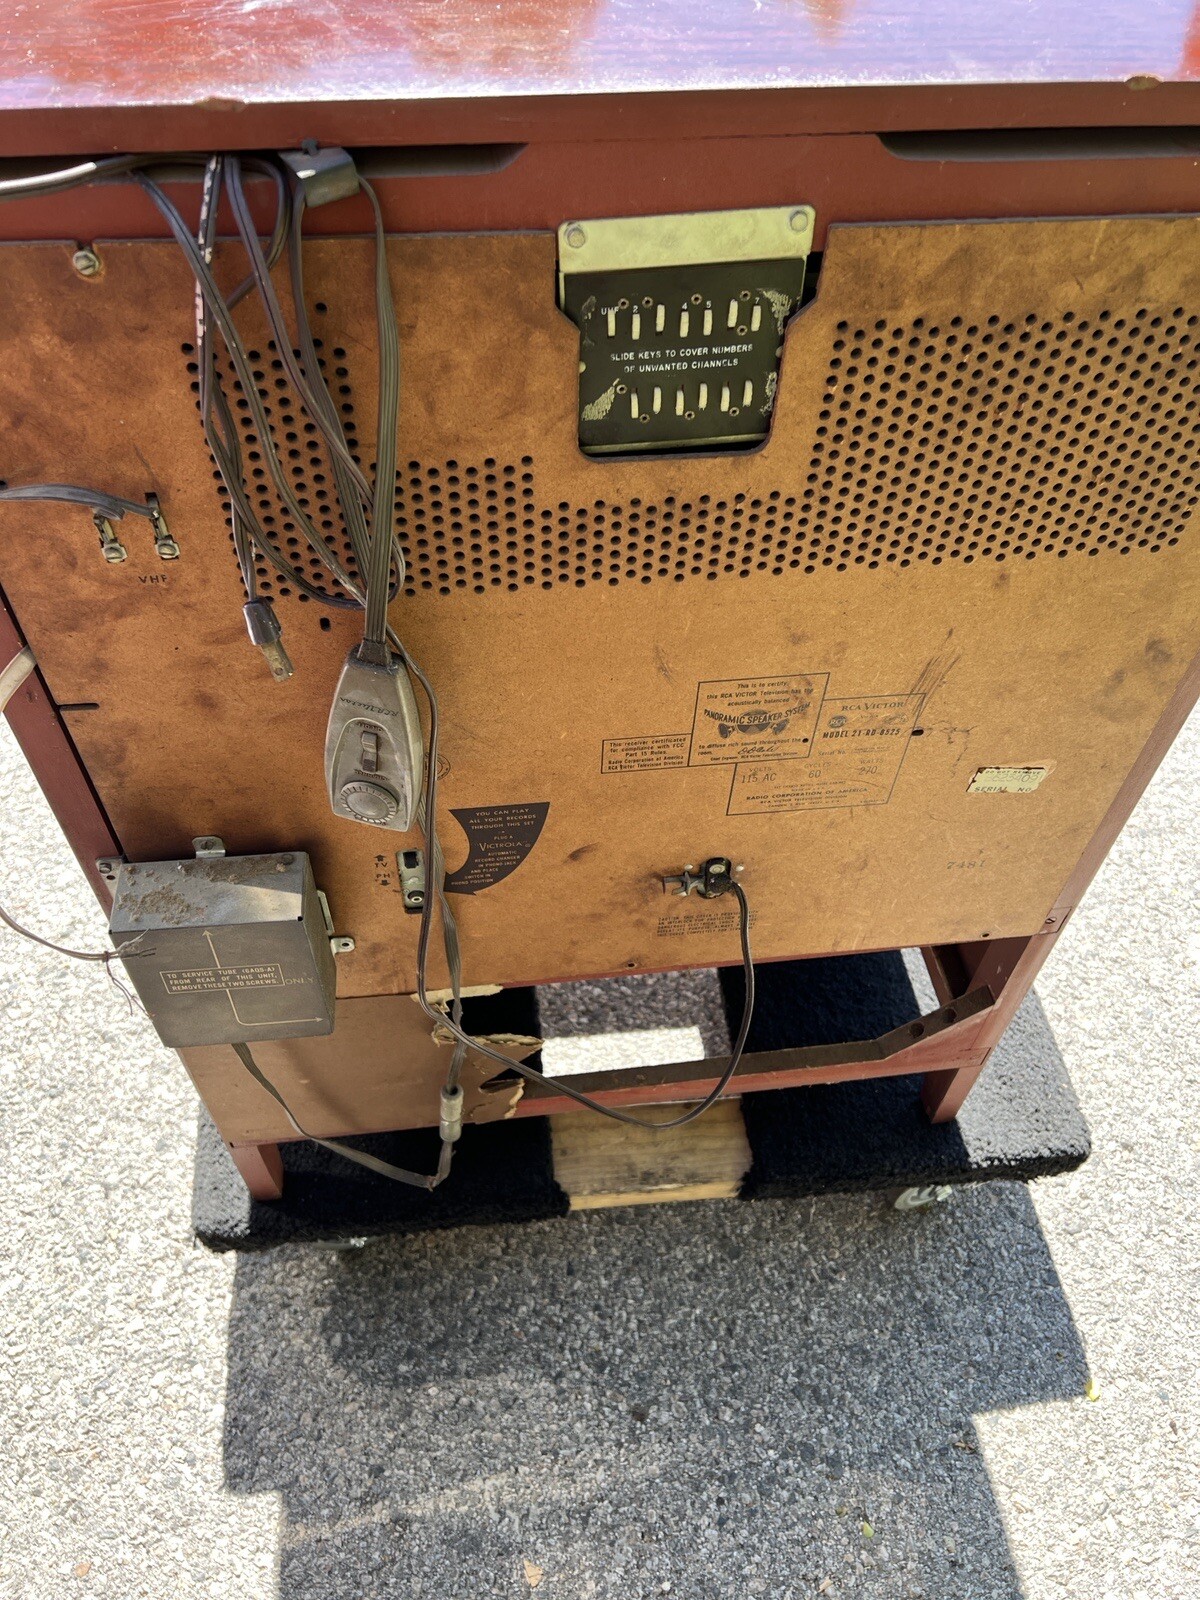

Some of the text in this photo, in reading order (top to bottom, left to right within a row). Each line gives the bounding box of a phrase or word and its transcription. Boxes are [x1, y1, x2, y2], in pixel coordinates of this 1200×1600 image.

[611, 344, 753, 361] SLIDE KEYS TO COVER NUMBERS
[624, 358, 738, 374] OF UNWANTED CHANNELS
[138, 574, 168, 584] VHF
[704, 702, 812, 724] PANORAMIC SPEAKER SYSTEM
[822, 730, 848, 739] MODEL
[741, 774, 758, 784] 115
[762, 772, 778, 782] AC
[808, 770, 822, 778] 60
[172, 984, 202, 992] REMOVE
